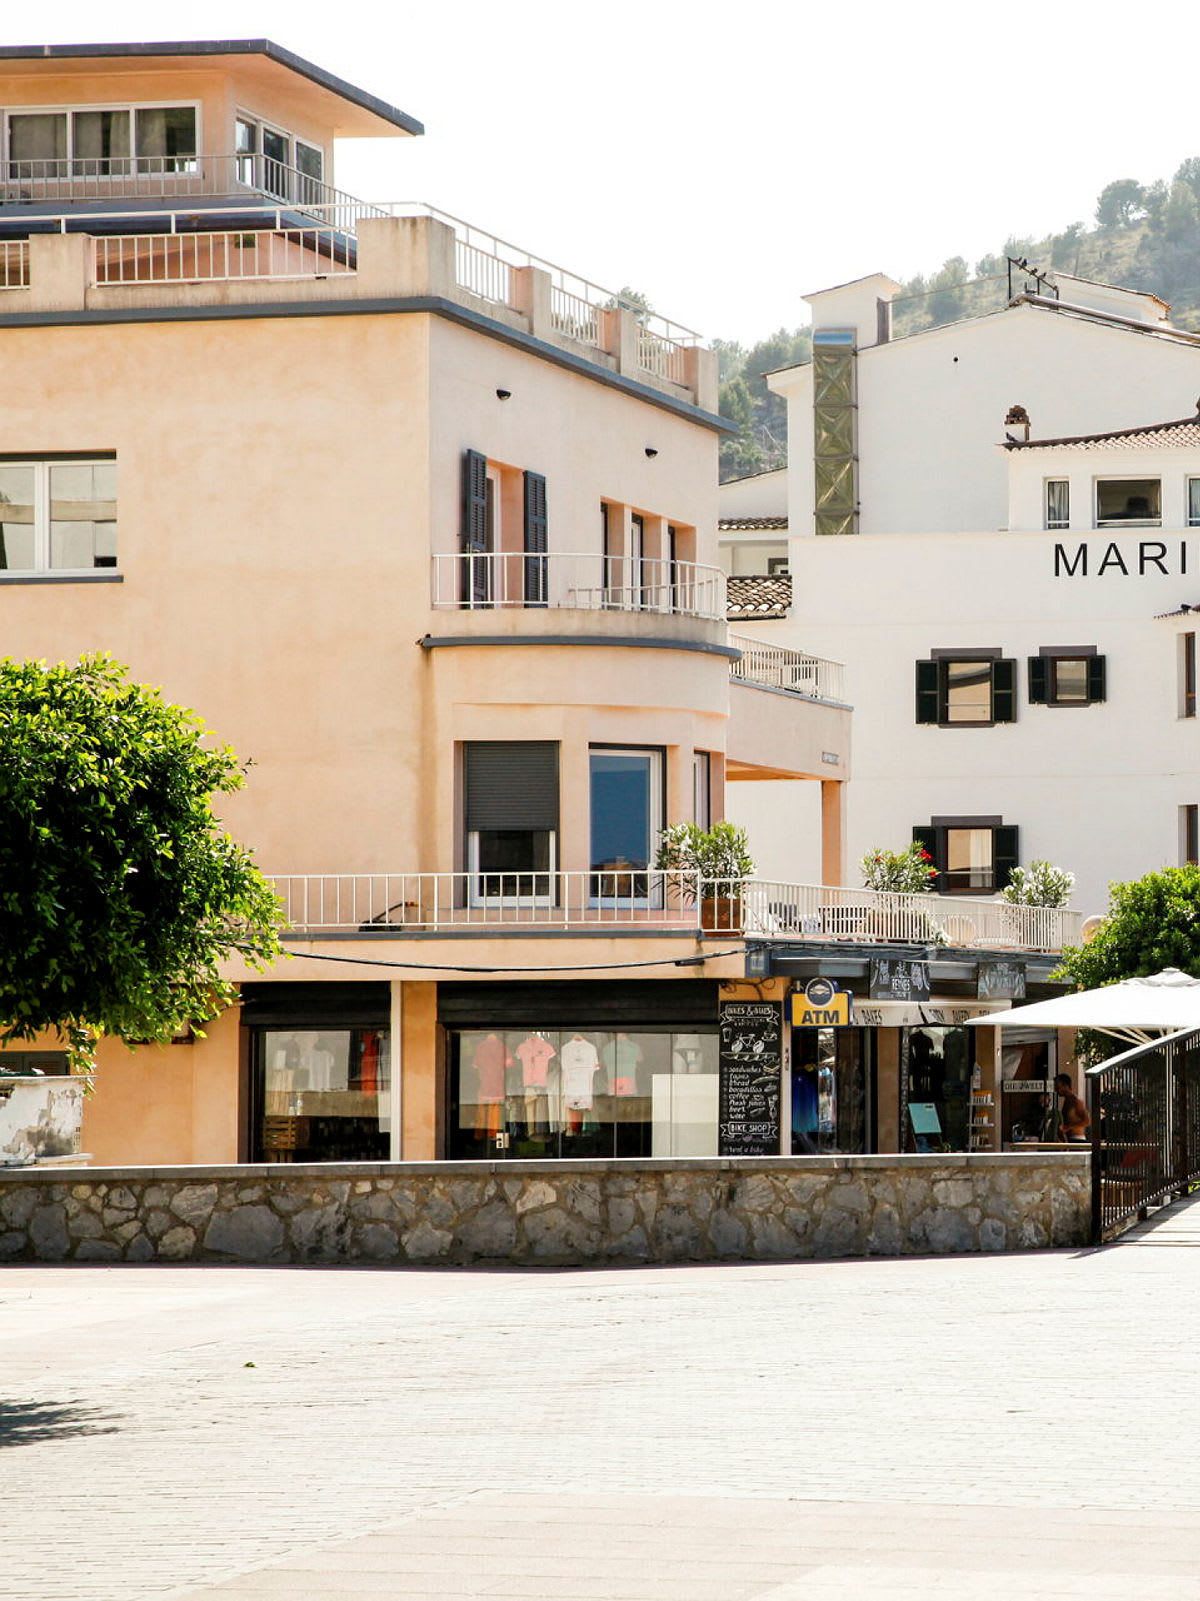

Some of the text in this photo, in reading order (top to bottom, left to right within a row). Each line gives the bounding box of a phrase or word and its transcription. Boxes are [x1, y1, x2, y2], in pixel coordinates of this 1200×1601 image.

[801, 1010, 840, 1024] ATM
[731, 1123, 768, 1132] BIKE SHOP
